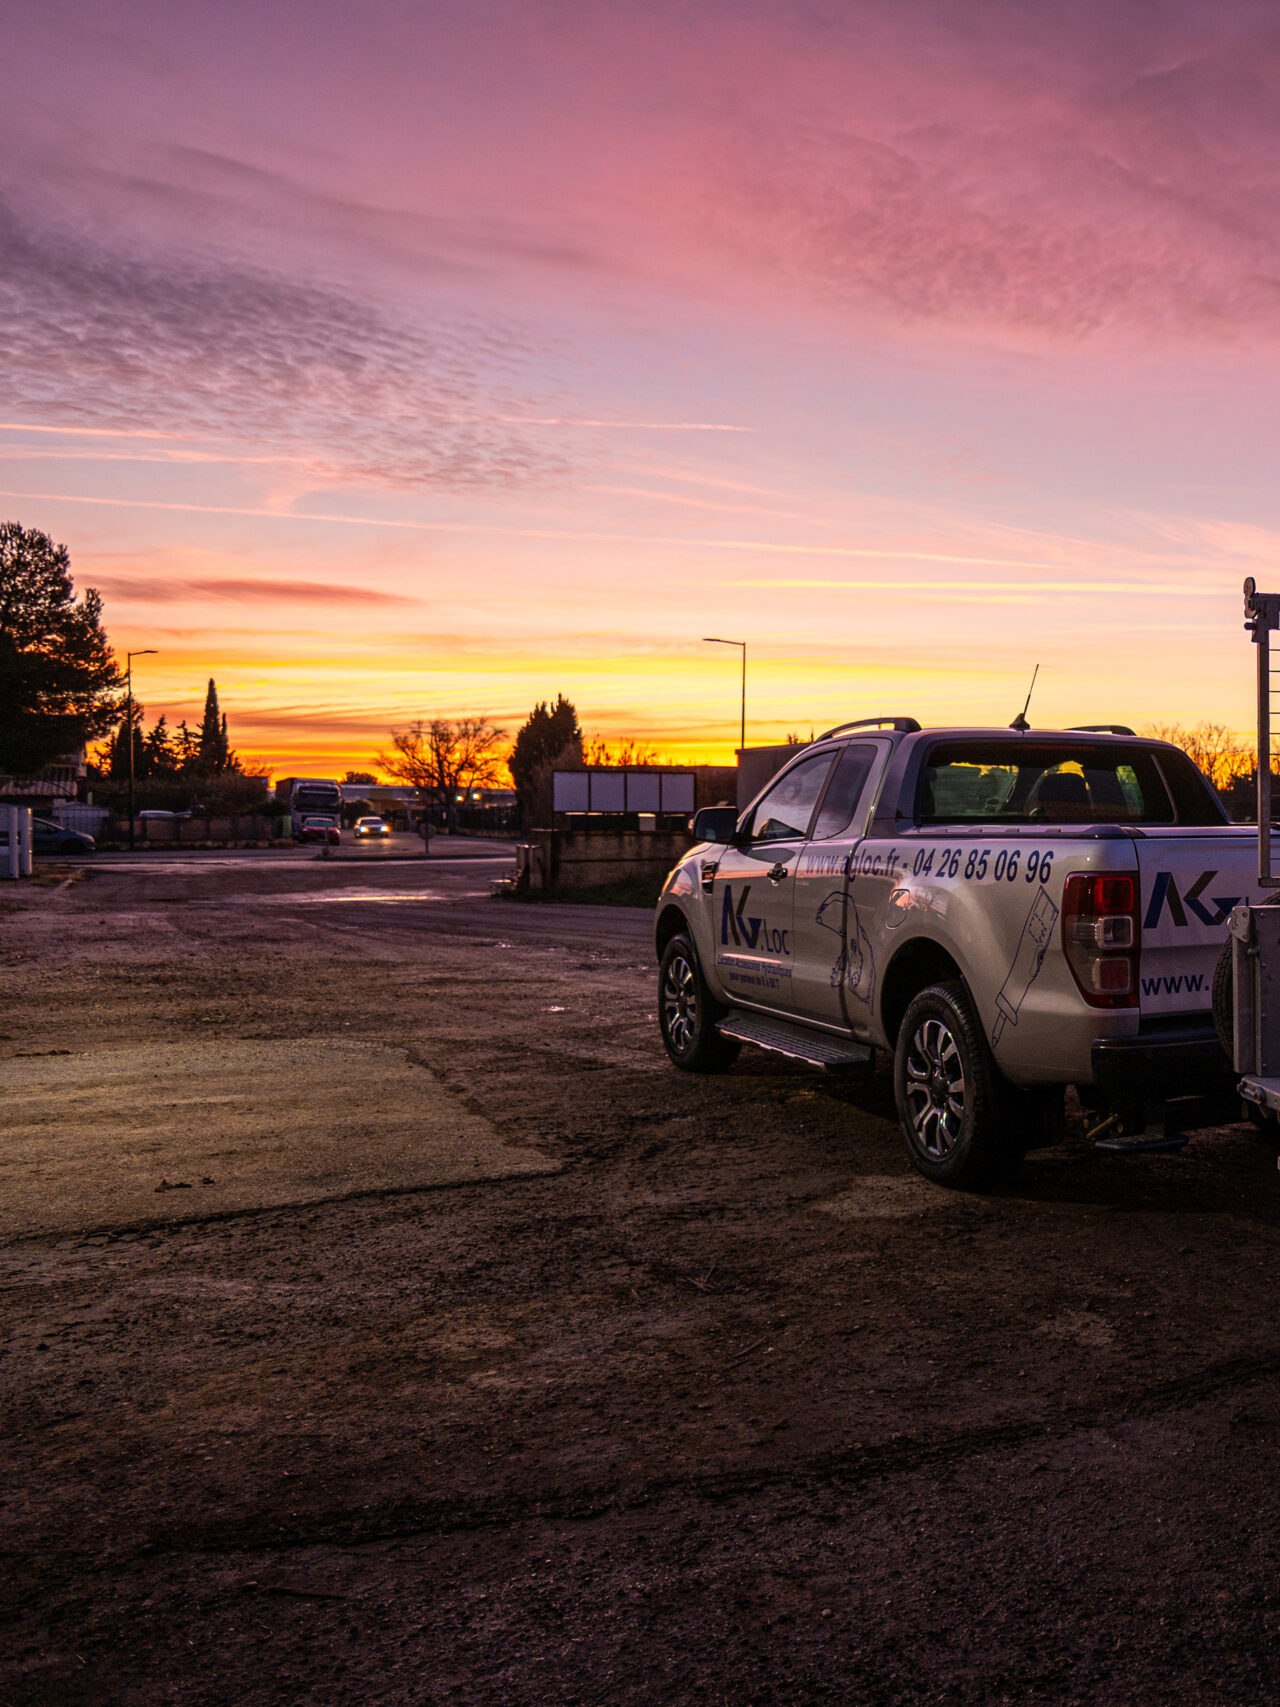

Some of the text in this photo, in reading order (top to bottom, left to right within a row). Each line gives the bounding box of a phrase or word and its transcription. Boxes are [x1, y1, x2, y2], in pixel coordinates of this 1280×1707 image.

[913, 849, 937, 877] 04
[936, 849, 962, 878] 26
[965, 849, 992, 880] 85
[994, 850, 1021, 882] 06
[1025, 850, 1055, 884] 96
[1141, 974, 1210, 996] www.
